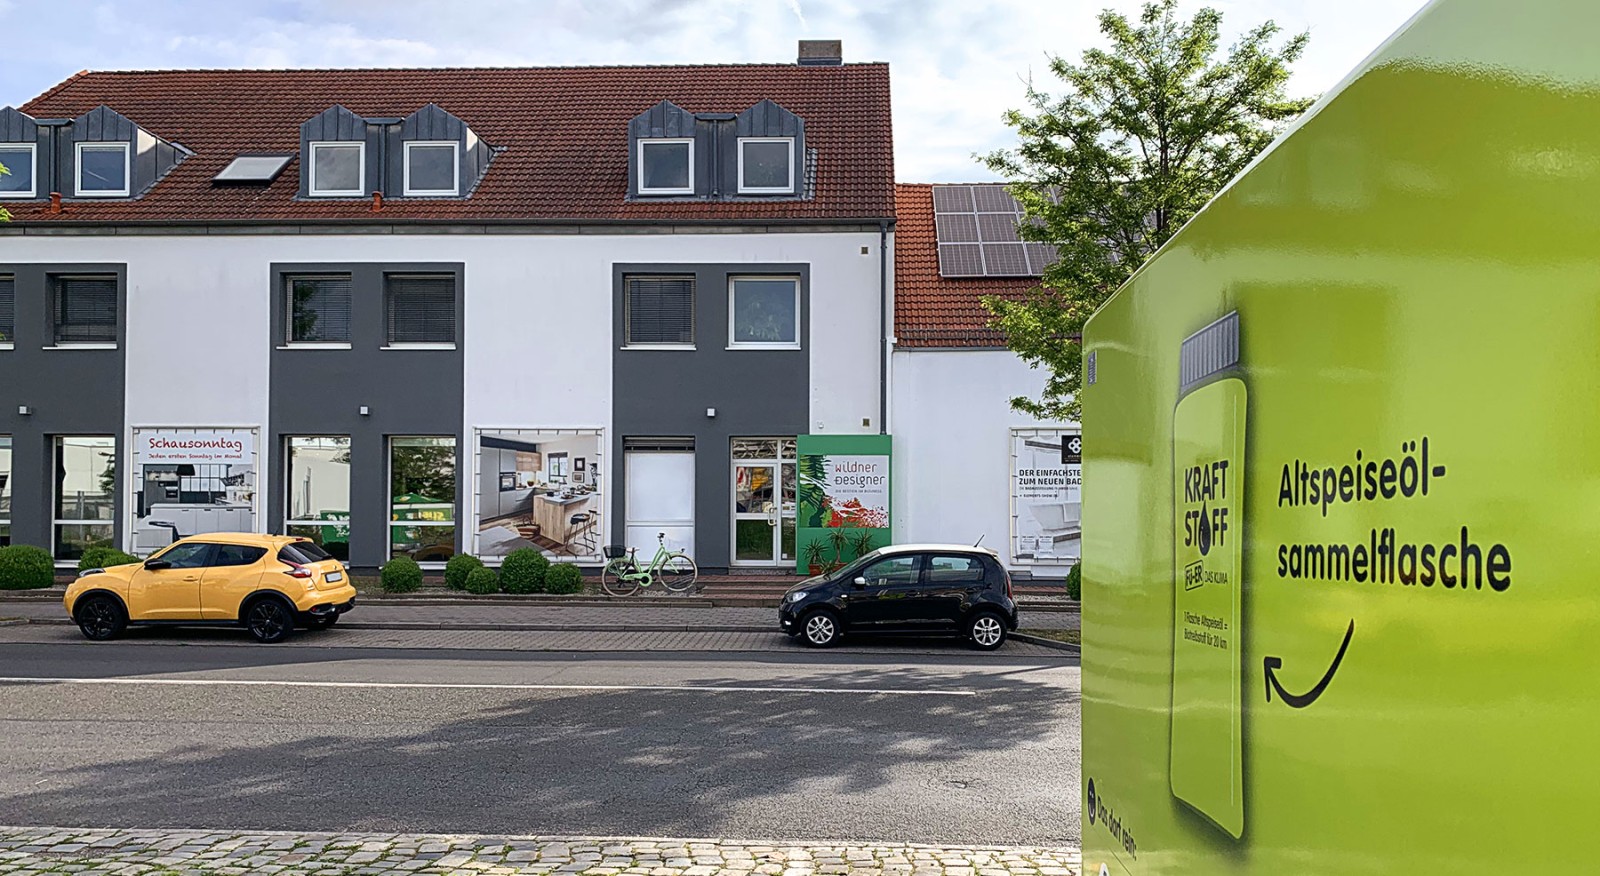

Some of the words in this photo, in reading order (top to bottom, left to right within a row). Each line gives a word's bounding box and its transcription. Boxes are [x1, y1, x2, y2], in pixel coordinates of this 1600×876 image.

[148, 437, 243, 453] Schausonntag
[1018, 469, 1035, 477] DER
[1036, 469, 1082, 477] EINFACHSTE
[1018, 477, 1036, 485] ZUM
[1038, 477, 1064, 485] NEUEN
[1185, 460, 1229, 503] KRAFT
[1278, 436, 1446, 517] Altspeiseöl-
[1277, 525, 1512, 592] sammelflasche
[1204, 570, 1214, 584] DAS
[1214, 571, 1228, 585] KLIMA
[1097, 795, 1108, 828] Das
[1108, 807, 1122, 843] darf
[1122, 827, 1137, 862] rein:
